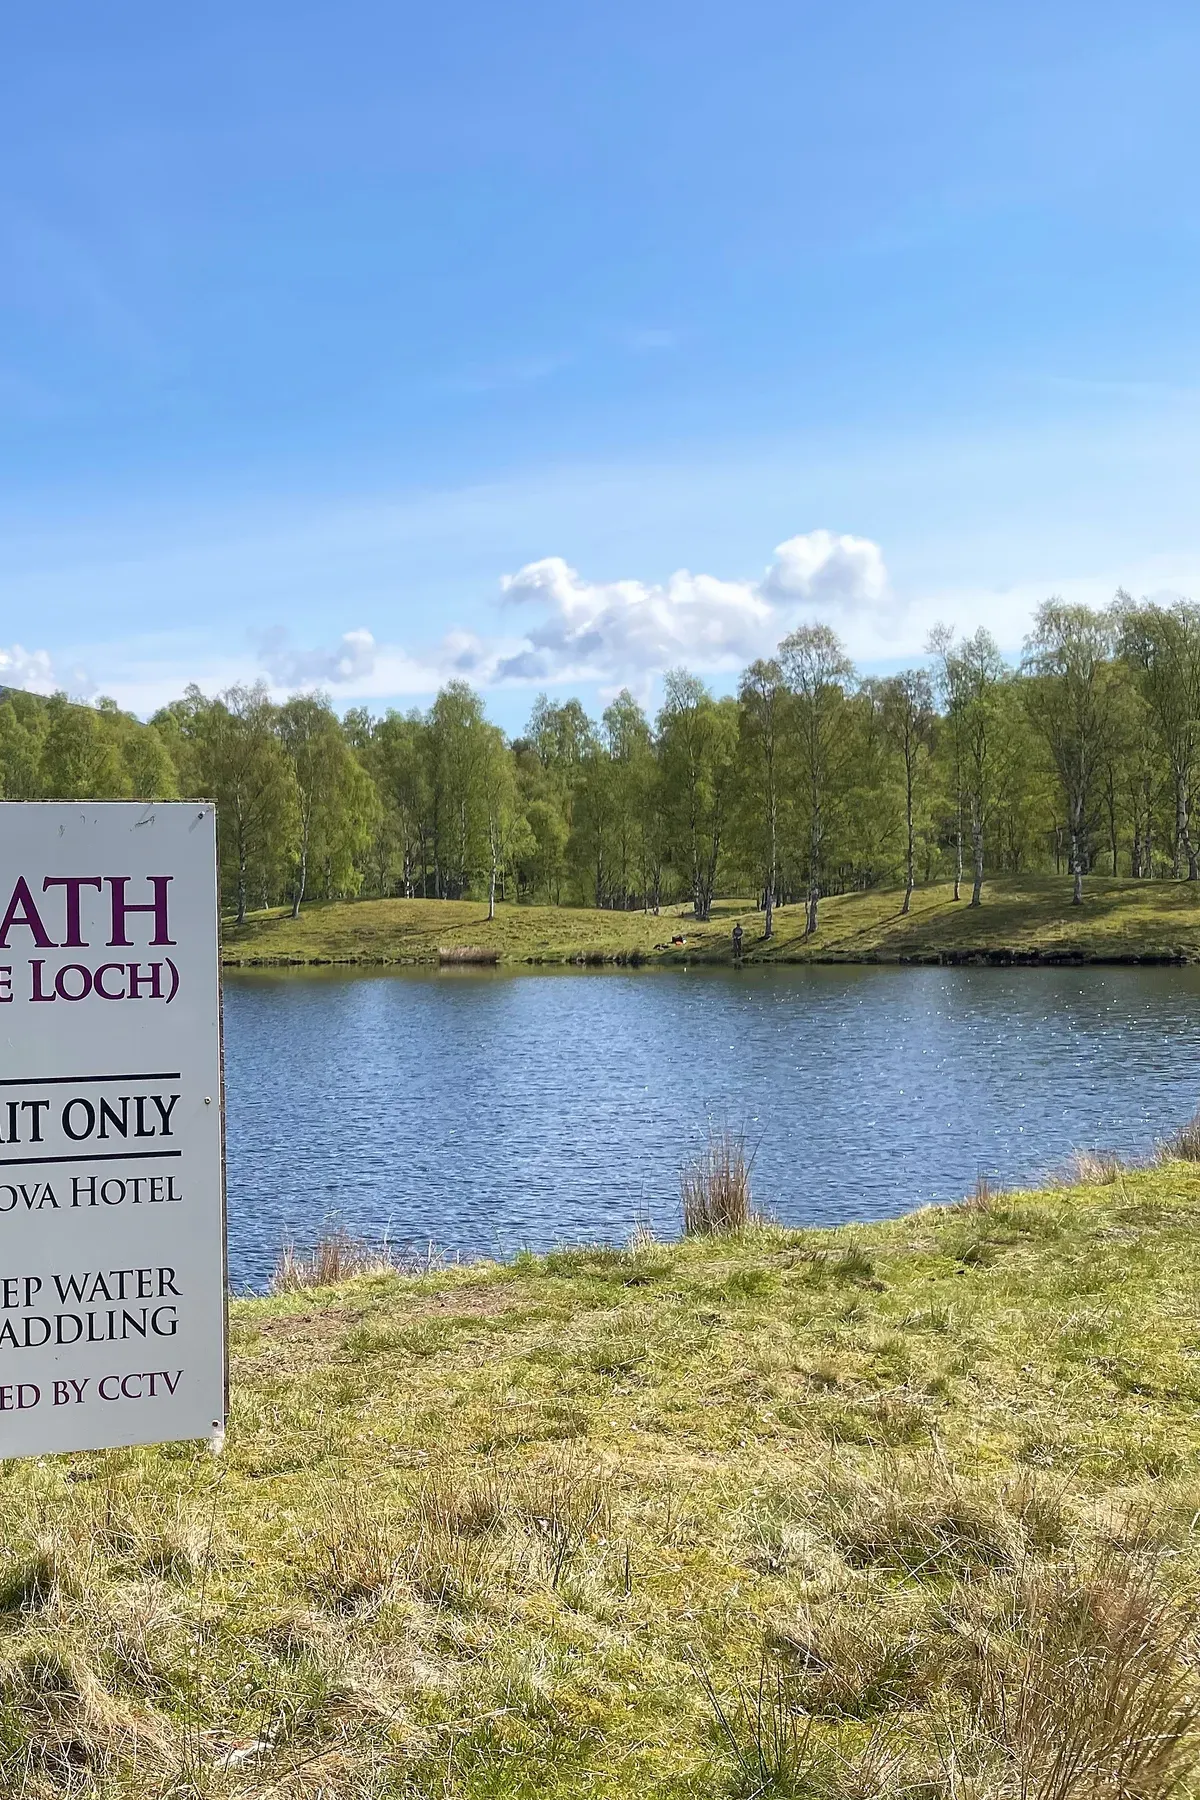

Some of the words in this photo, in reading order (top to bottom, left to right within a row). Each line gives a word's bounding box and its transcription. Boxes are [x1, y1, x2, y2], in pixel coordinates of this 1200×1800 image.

[28, 957, 180, 1004] LOCH)
[61, 1094, 181, 1140] ONLY
[69, 1175, 183, 1208] HOTEL
[51, 1266, 183, 1302] WATER
[52, 1377, 91, 1408] BY
[98, 1370, 184, 1401] CCTV
